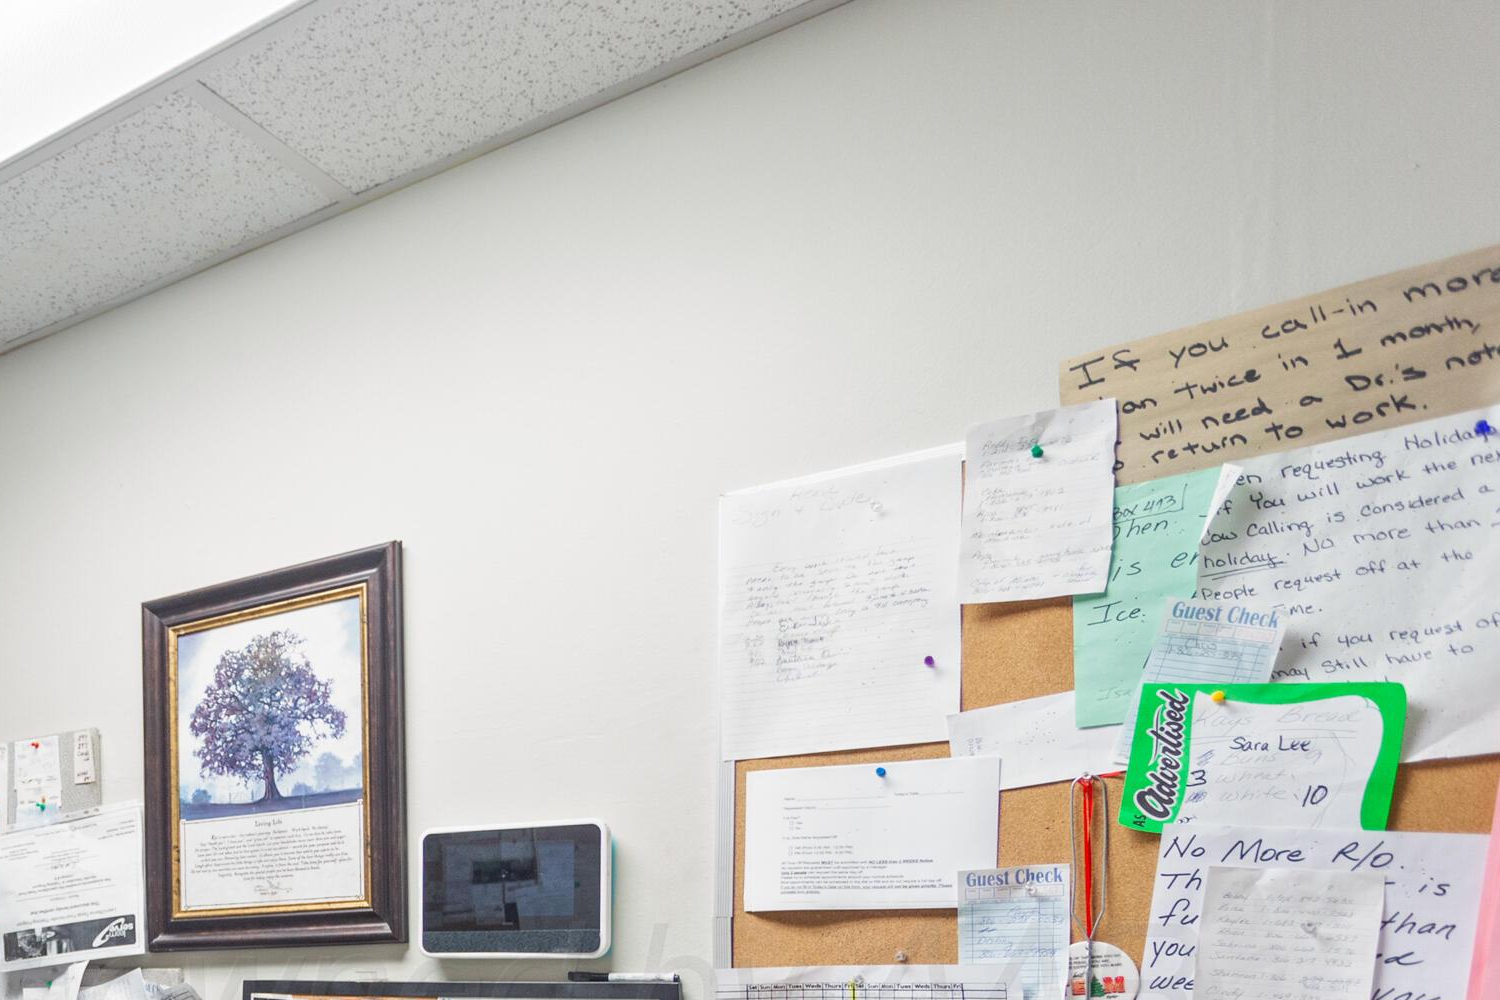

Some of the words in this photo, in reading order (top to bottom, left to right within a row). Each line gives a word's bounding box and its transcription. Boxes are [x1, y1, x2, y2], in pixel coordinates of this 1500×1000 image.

[1070, 350, 1140, 390] If
[1170, 337, 1229, 368] you
[1262, 299, 1377, 340] call-in
[1175, 369, 1261, 399] twice
[1278, 353, 1309, 370] in
[1141, 420, 1183, 442] will
[1202, 397, 1272, 428] need
[1300, 395, 1322, 406] a
[1152, 432, 1247, 464] return
[1266, 423, 1303, 439] to
[1281, 452, 1386, 481] requesting
[1298, 486, 1339, 502] will
[1357, 471, 1411, 489] work
[1422, 461, 1455, 474] the
[1327, 513, 1345, 523] is
[1479, 485, 1494, 493] a
[1303, 538, 1334, 556] No
[1354, 528, 1411, 543] more
[1425, 520, 1480, 534] than
[1113, 558, 1142, 581] is
[1275, 570, 1341, 591] request
[1356, 560, 1386, 575] off
[1397, 561, 1420, 570] at
[1441, 551, 1474, 562] the
[1172, 601, 1221, 621] Guest
[1227, 606, 1278, 628] Check
[1301, 633, 1321, 648] if
[1338, 632, 1373, 648] you
[1389, 622, 1461, 642] request
[1271, 667, 1310, 681] may
[1386, 648, 1432, 664] have
[1448, 644, 1474, 654] to
[1230, 736, 1270, 753] Sara
[1279, 737, 1311, 753] Lee
[1164, 836, 1205, 858] No
[1221, 839, 1305, 863] More
[966, 872, 1009, 887] Guest
[1015, 868, 1062, 885] Check
[1419, 877, 1449, 896] is
[1380, 911, 1456, 939] than
